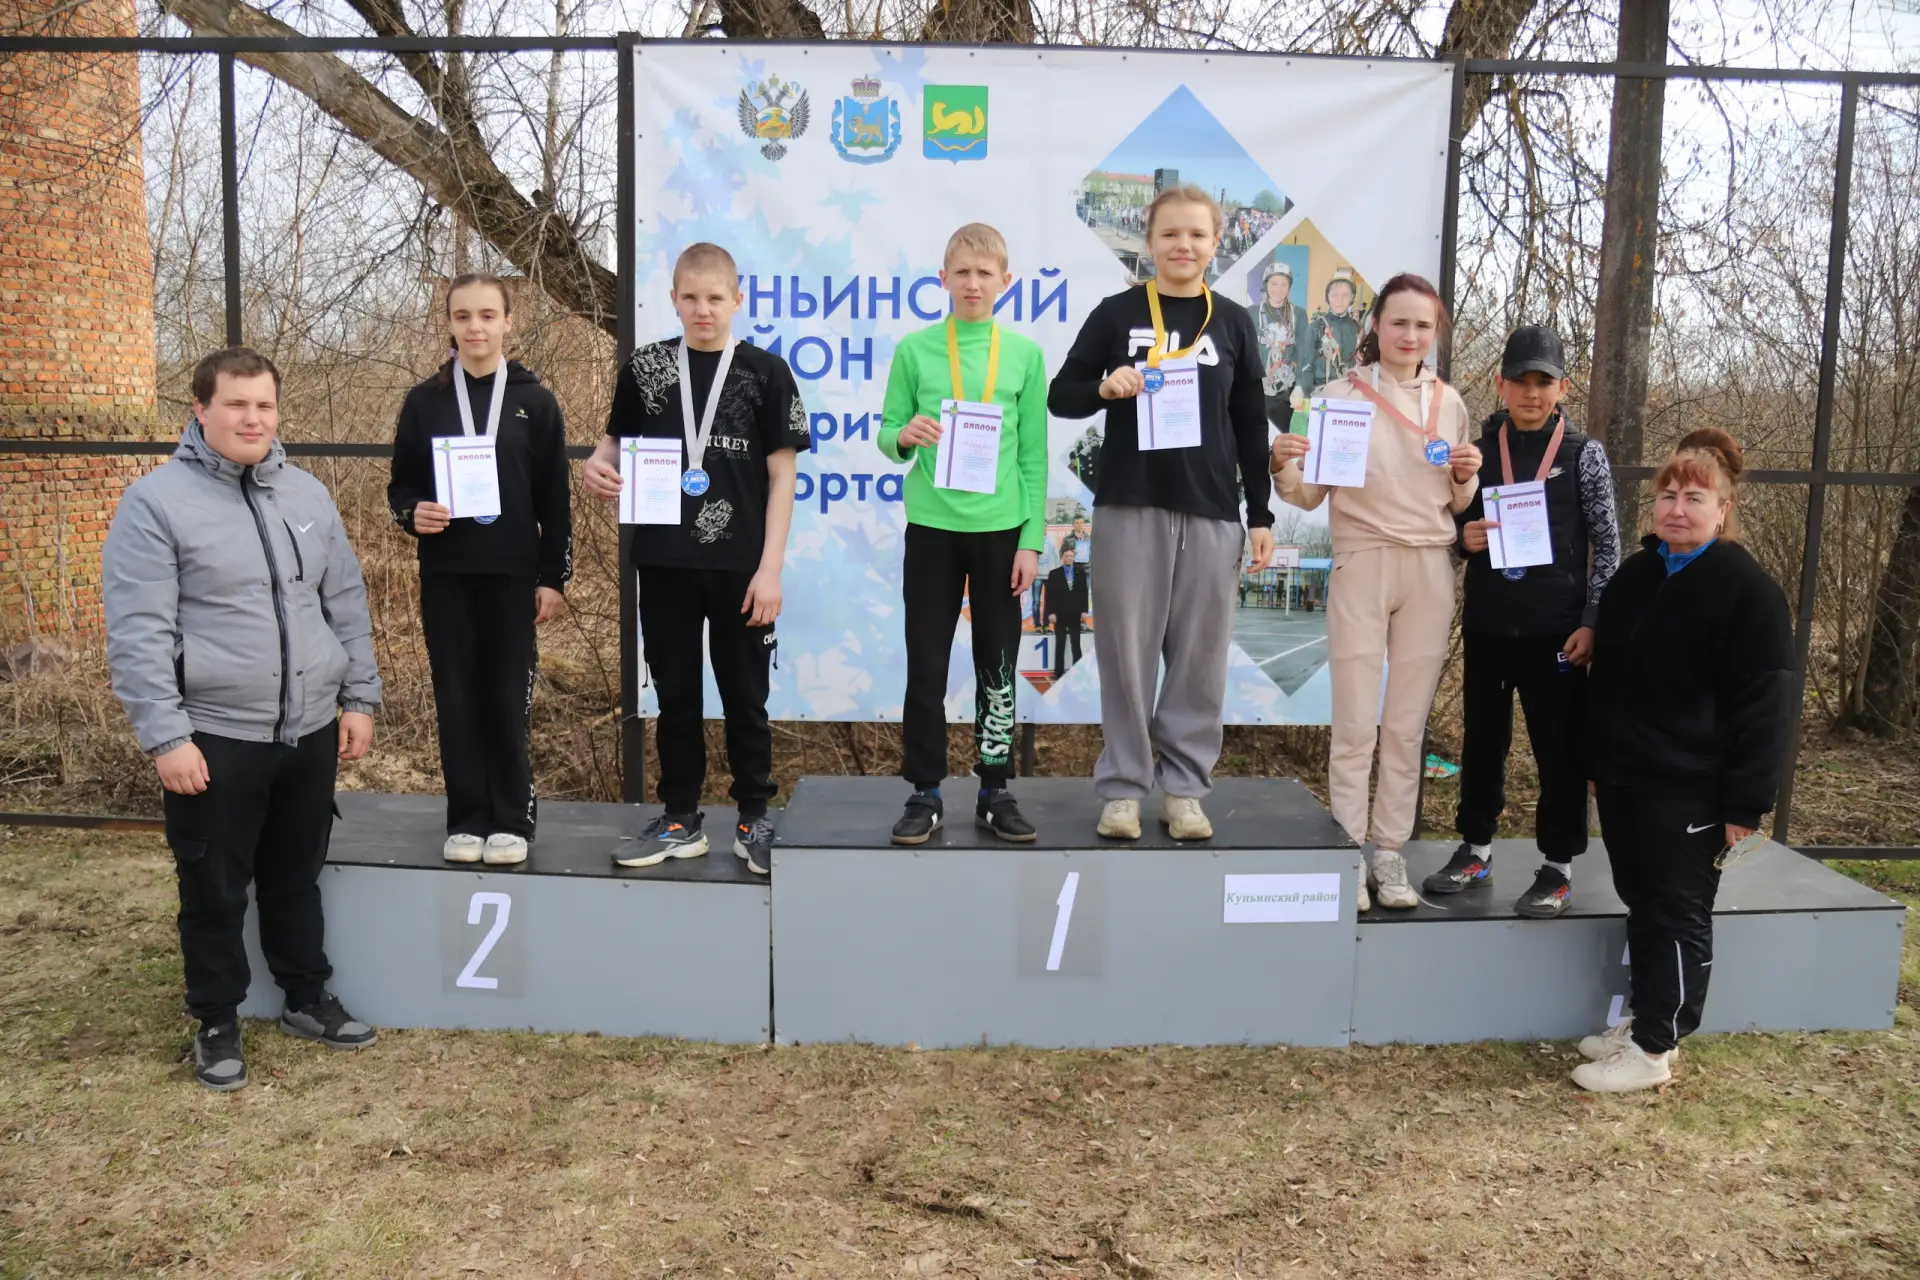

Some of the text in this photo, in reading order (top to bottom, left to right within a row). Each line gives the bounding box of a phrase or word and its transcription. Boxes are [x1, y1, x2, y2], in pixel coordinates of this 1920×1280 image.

[1164, 378, 1194, 388] ИПЛОМ
[963, 422, 997, 432] ДИПЛОМ
[1331, 419, 1367, 428] ДИПЛОМ
[643, 458, 678, 466] ДИПЛОМ
[794, 472, 904, 514] орта
[1507, 499, 1541, 510] ДИПЛОМ
[1034, 637, 1049, 669] 1
[1226, 891, 1338, 906] Куньинский район
[1046, 872, 1080, 972] 1
[456, 892, 512, 990] 2
